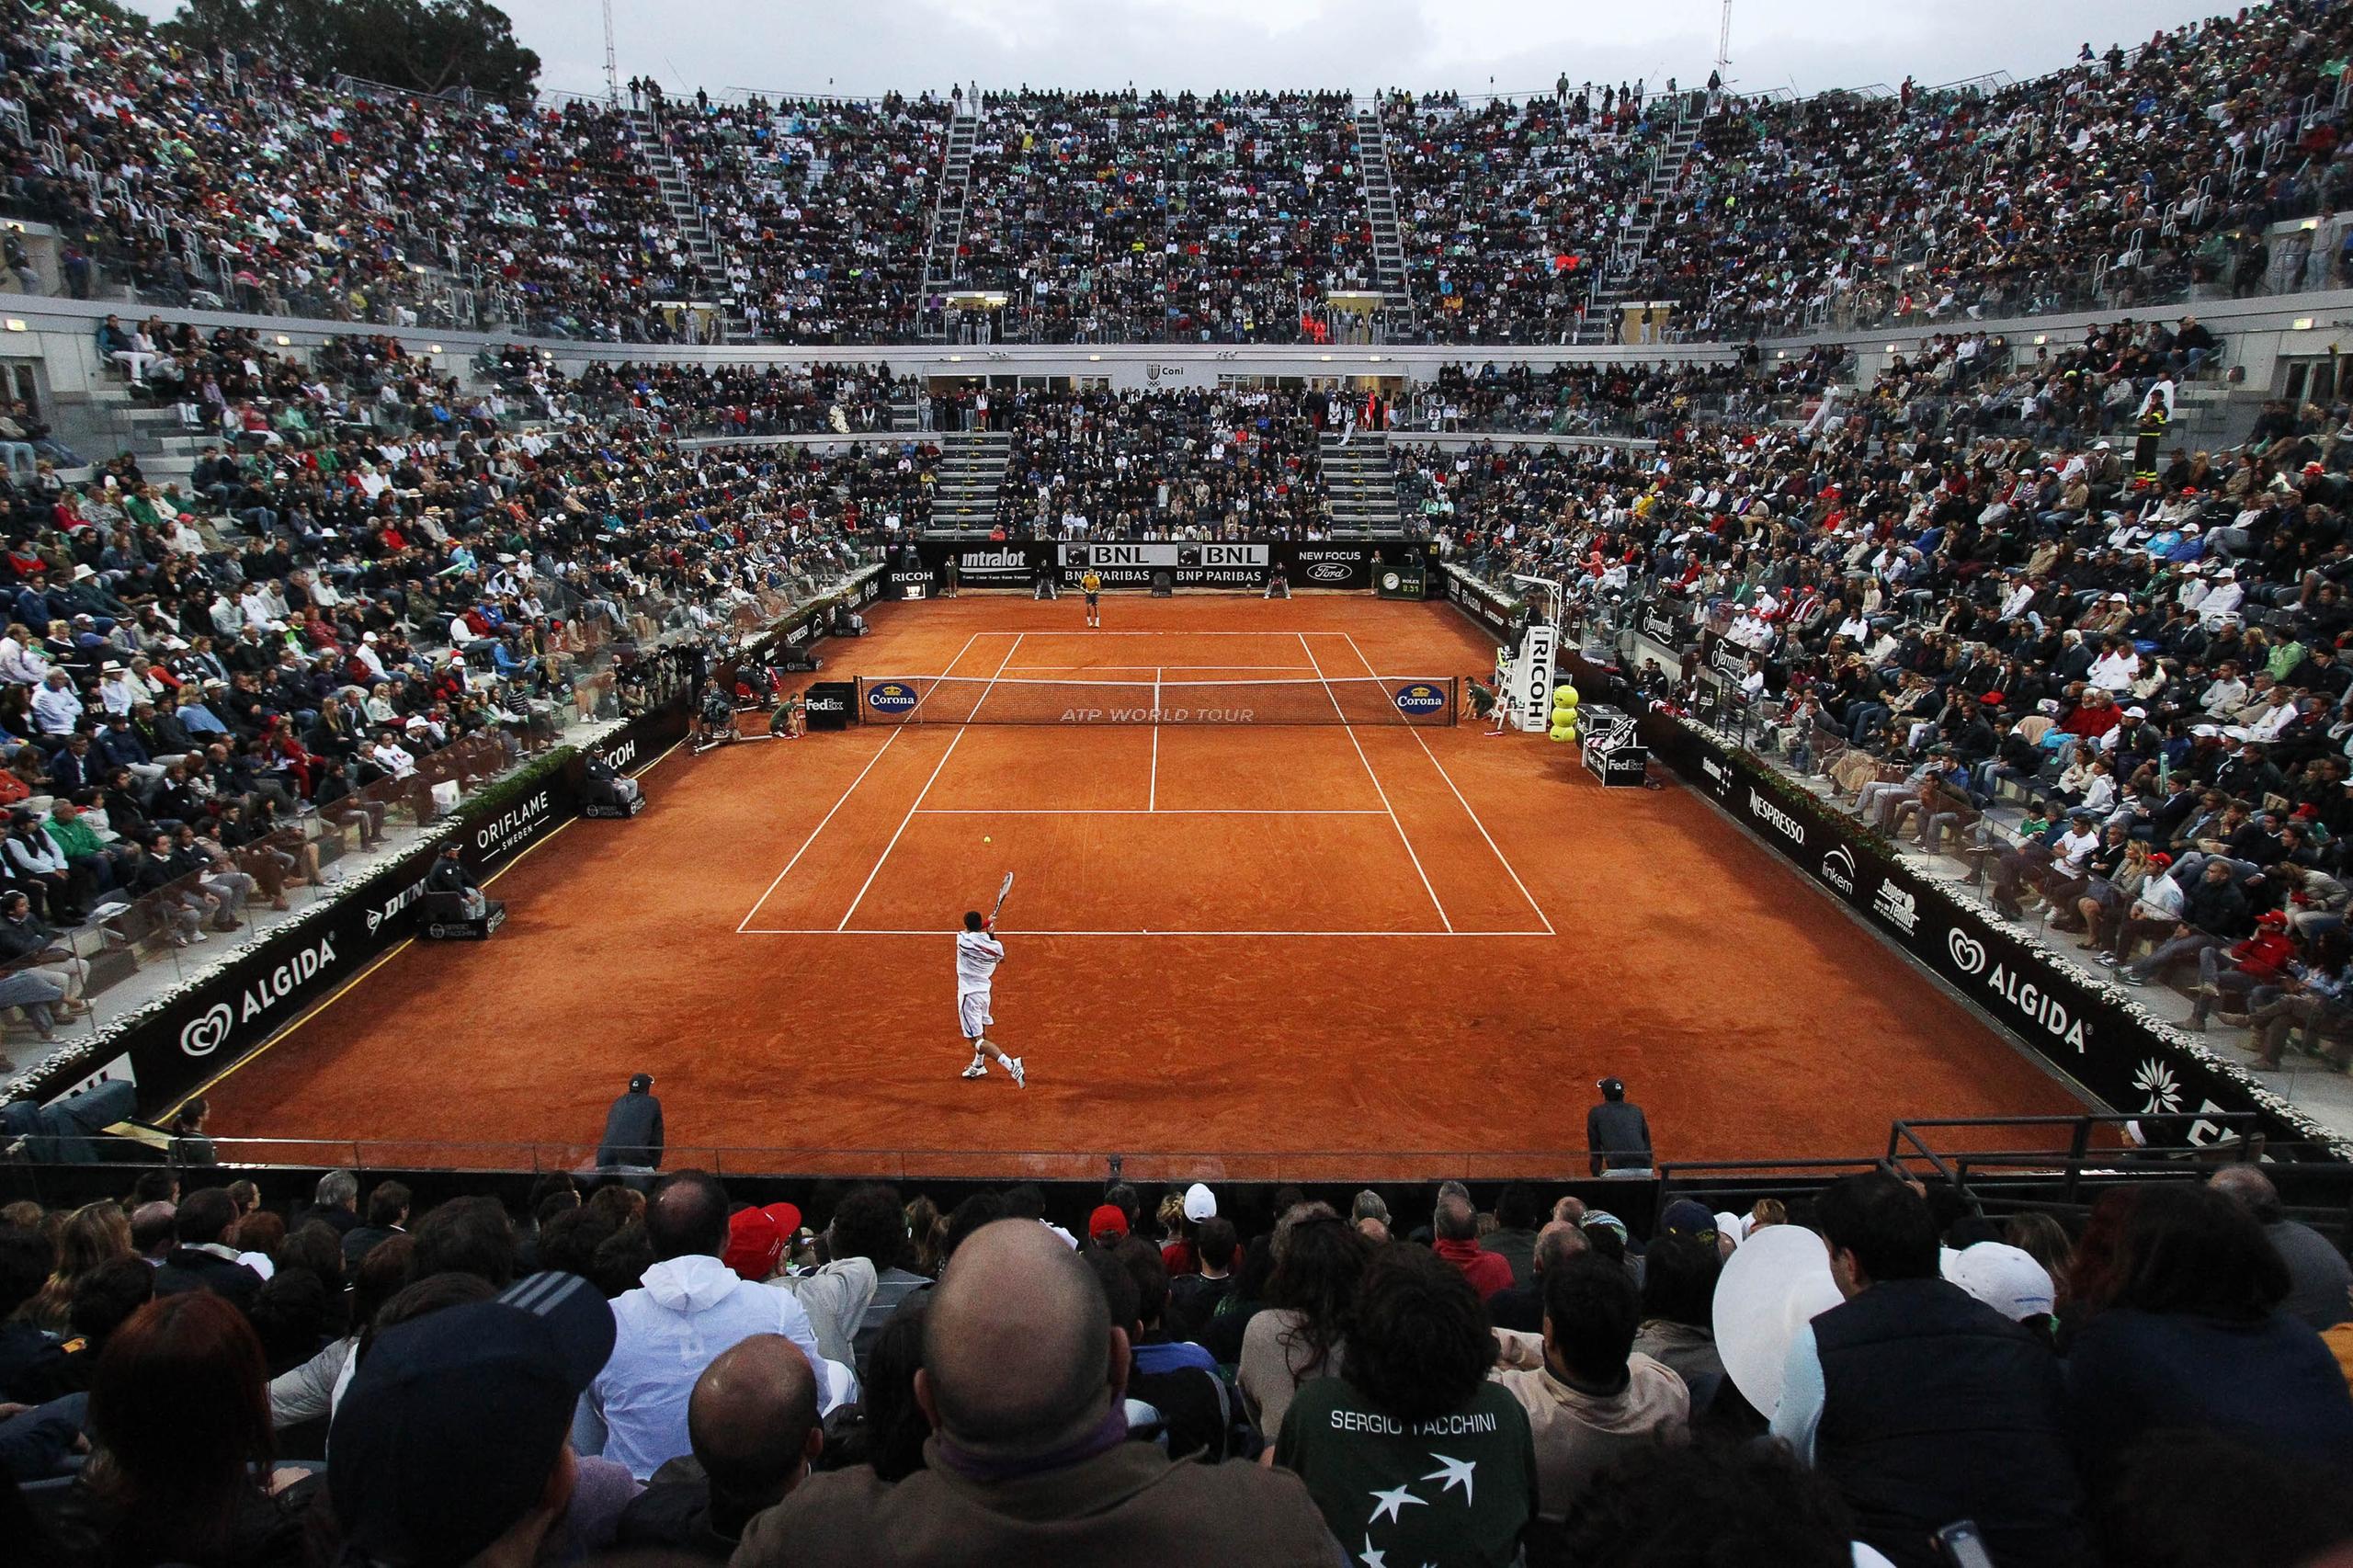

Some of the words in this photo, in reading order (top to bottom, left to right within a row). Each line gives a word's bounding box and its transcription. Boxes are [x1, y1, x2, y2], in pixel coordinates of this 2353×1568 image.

[1162, 367, 1184, 375] Coni
[961, 546, 1026, 566] intralot
[1095, 546, 1149, 563] BNL
[1206, 546, 1260, 563] BNL
[1299, 551, 1325, 561] NEW
[1327, 551, 1361, 561] FOCUS
[892, 572, 934, 582] RICOH
[1095, 571, 1150, 581] PARIBAS
[1176, 571, 1202, 581] BNP
[1206, 571, 1261, 581] PARIBAS
[1314, 566, 1346, 578] Ford
[1711, 638, 1750, 675] Ferrarell
[1528, 639, 1549, 718] RICOH
[805, 698, 844, 711] FedEx
[870, 695, 915, 706] Corona
[1397, 696, 1442, 707] Corona
[1060, 709, 1102, 722] ATP
[1109, 709, 1188, 722] WORLD
[1196, 709, 1255, 722] TOUR
[603, 739, 635, 770] COH
[1608, 758, 1644, 771] FedEx
[477, 790, 549, 848] ORIFLAME
[1749, 786, 1804, 844] NESPRESSO
[502, 824, 533, 850] SWEDEN
[1822, 860, 1853, 895] linkem
[1881, 878, 1906, 903] Super
[1889, 901, 1915, 928] Tennis
[242, 937, 336, 1024] ALGIDA
[1988, 962, 2085, 1054] ALGIDA
[1331, 1410, 1402, 1435] SERGIO
